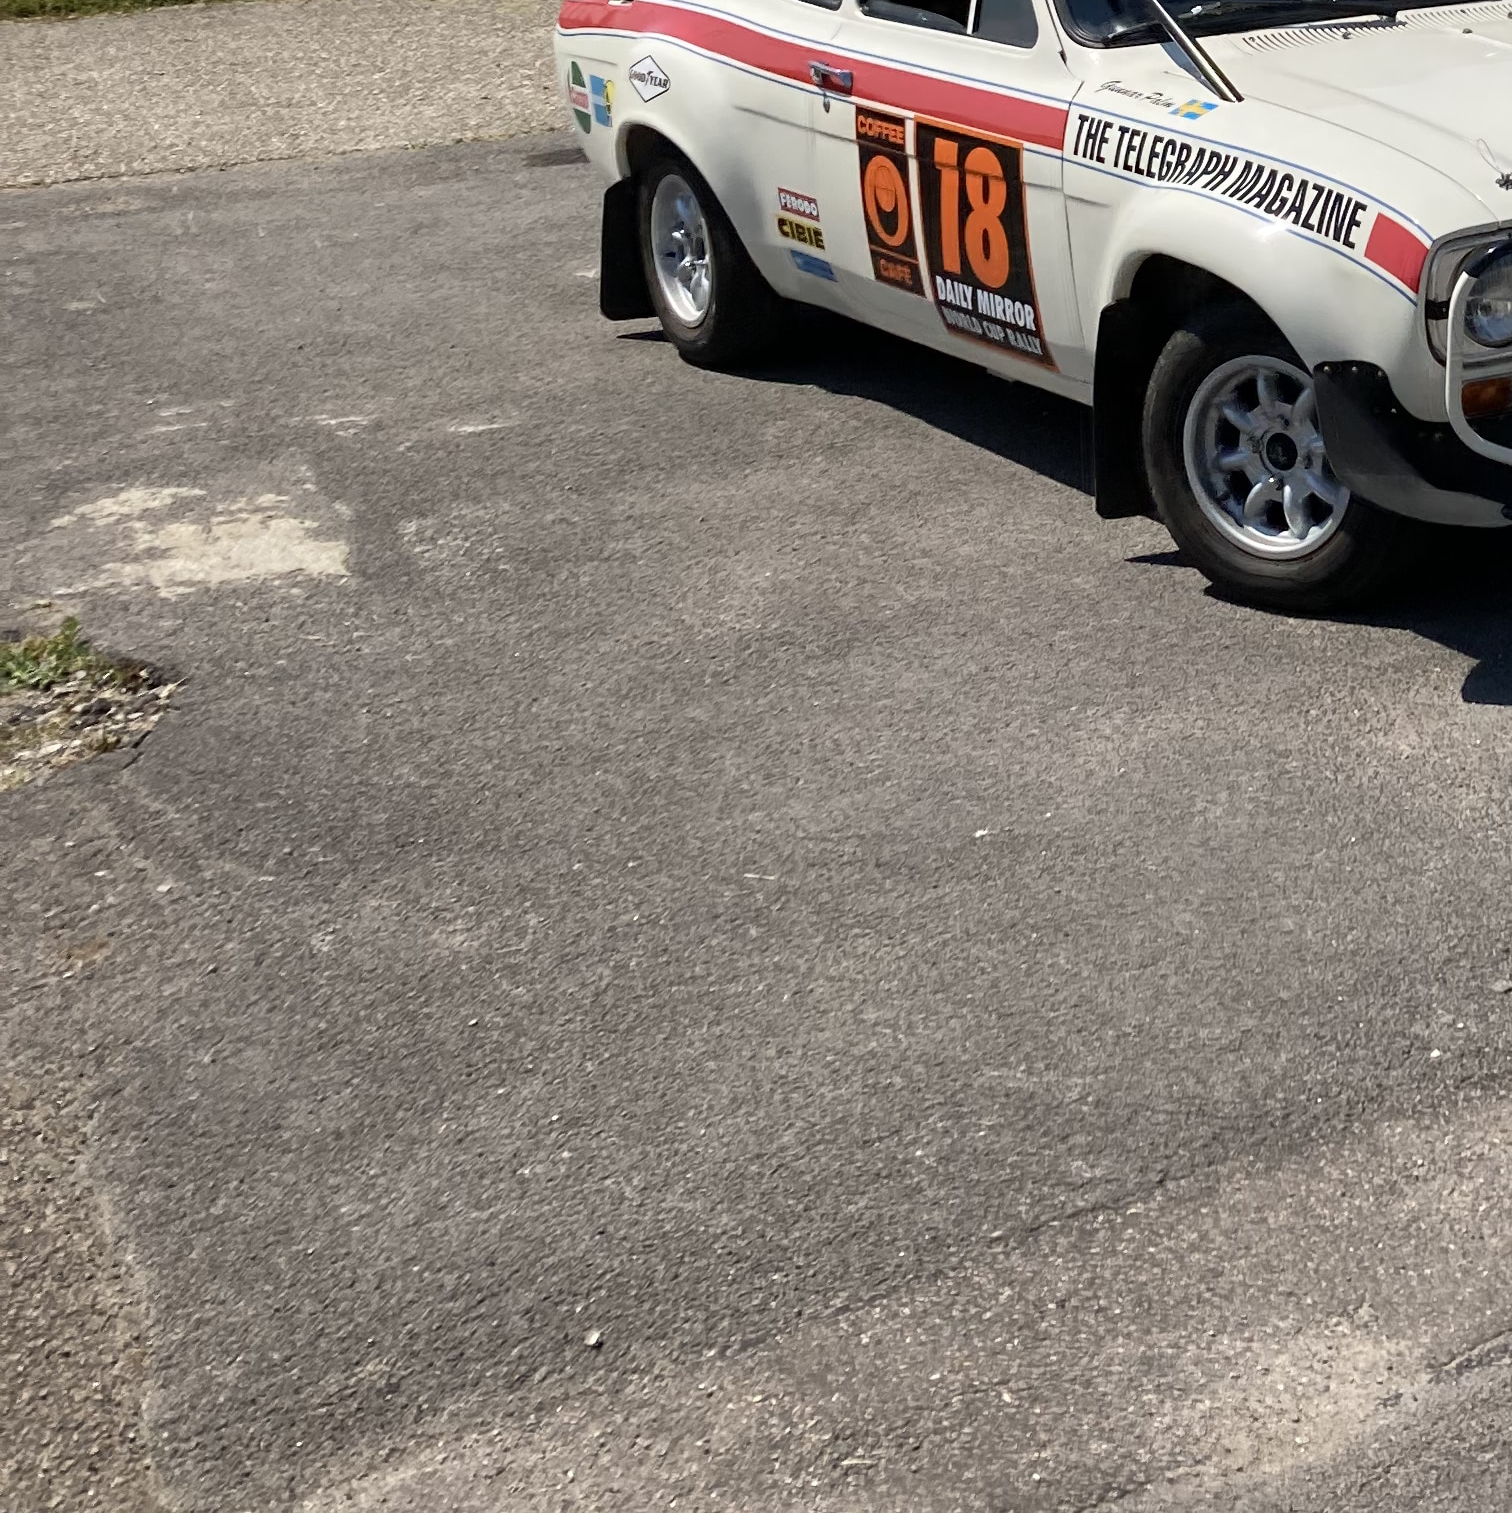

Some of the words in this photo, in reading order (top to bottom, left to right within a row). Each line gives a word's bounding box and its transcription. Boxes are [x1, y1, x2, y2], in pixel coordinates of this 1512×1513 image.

[857, 114, 905, 144] COFFEE
[1073, 114, 1114, 164] THE
[1113, 124, 1239, 192] TELEGRAPH
[1226, 160, 1368, 250] MAGAZINE
[779, 192, 818, 217] FERODO
[933, 137, 1010, 289] 18
[935, 275, 974, 310] DAILY
[976, 288, 1037, 331] MIRROR
[1005, 327, 1044, 356] RALLY
